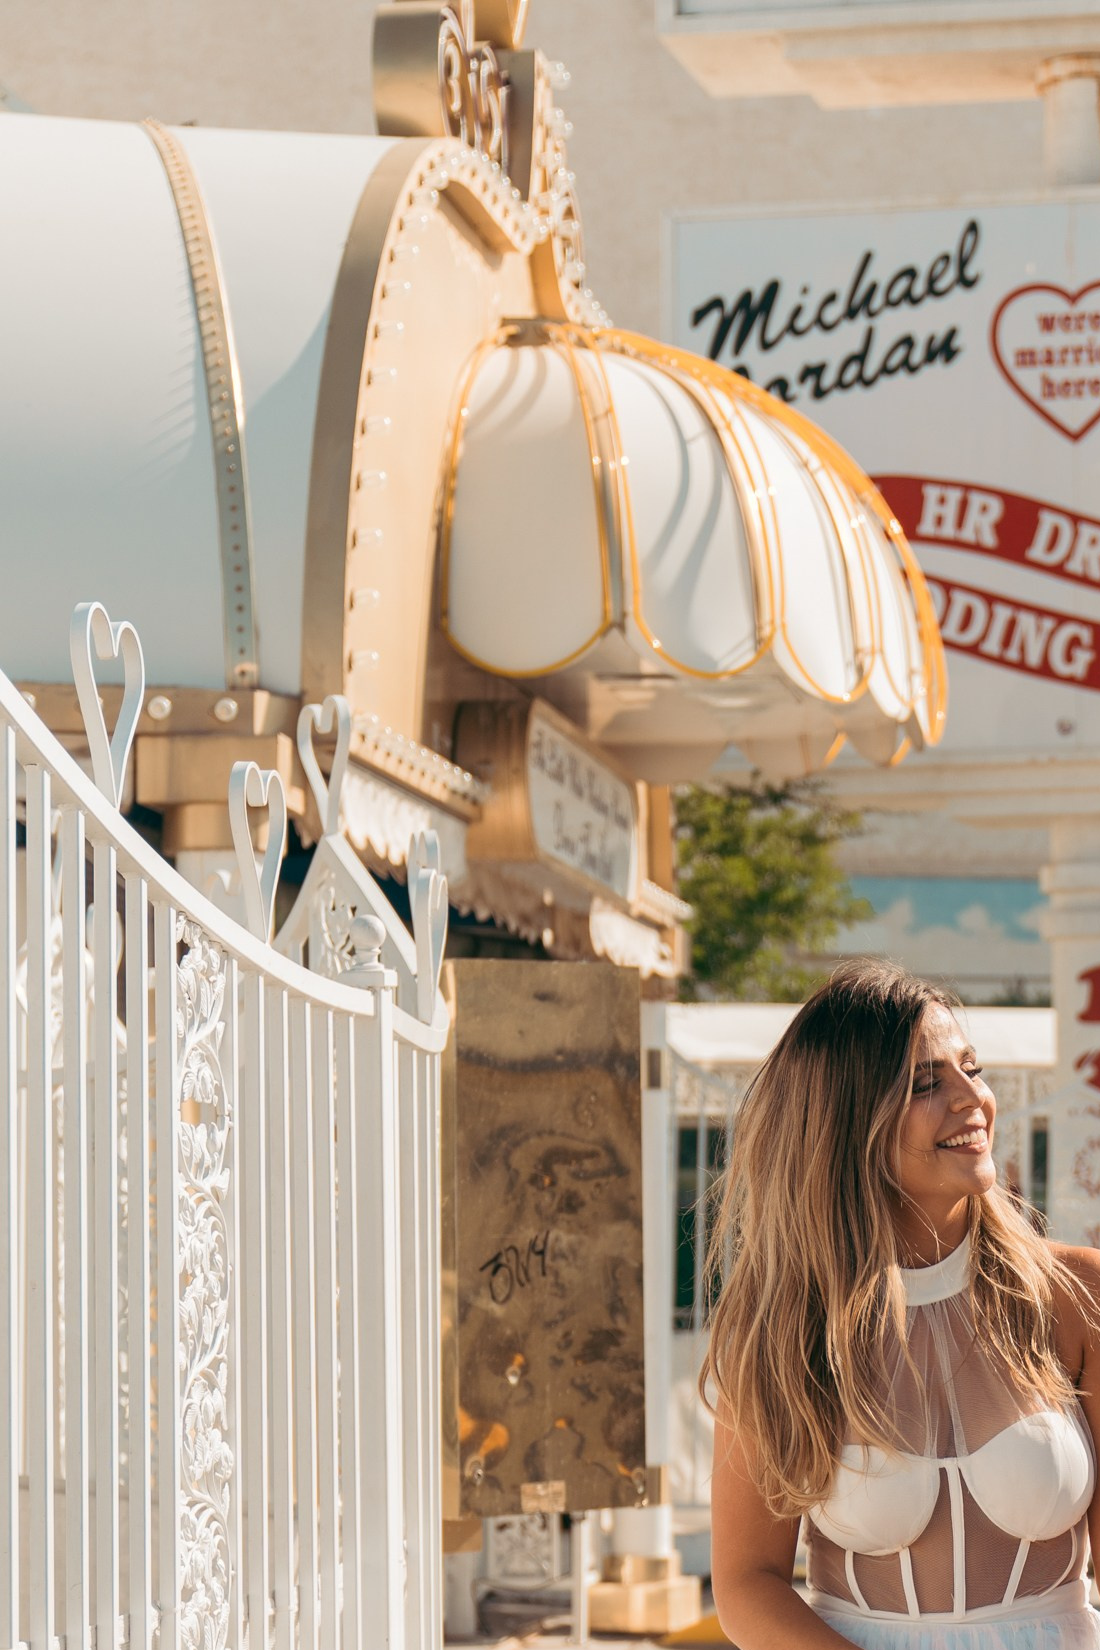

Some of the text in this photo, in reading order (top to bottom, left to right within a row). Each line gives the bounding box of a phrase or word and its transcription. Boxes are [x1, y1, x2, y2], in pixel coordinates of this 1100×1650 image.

[691, 219, 980, 360] Michael
[733, 325, 960, 402] ordan
[916, 484, 1005, 548] HR
